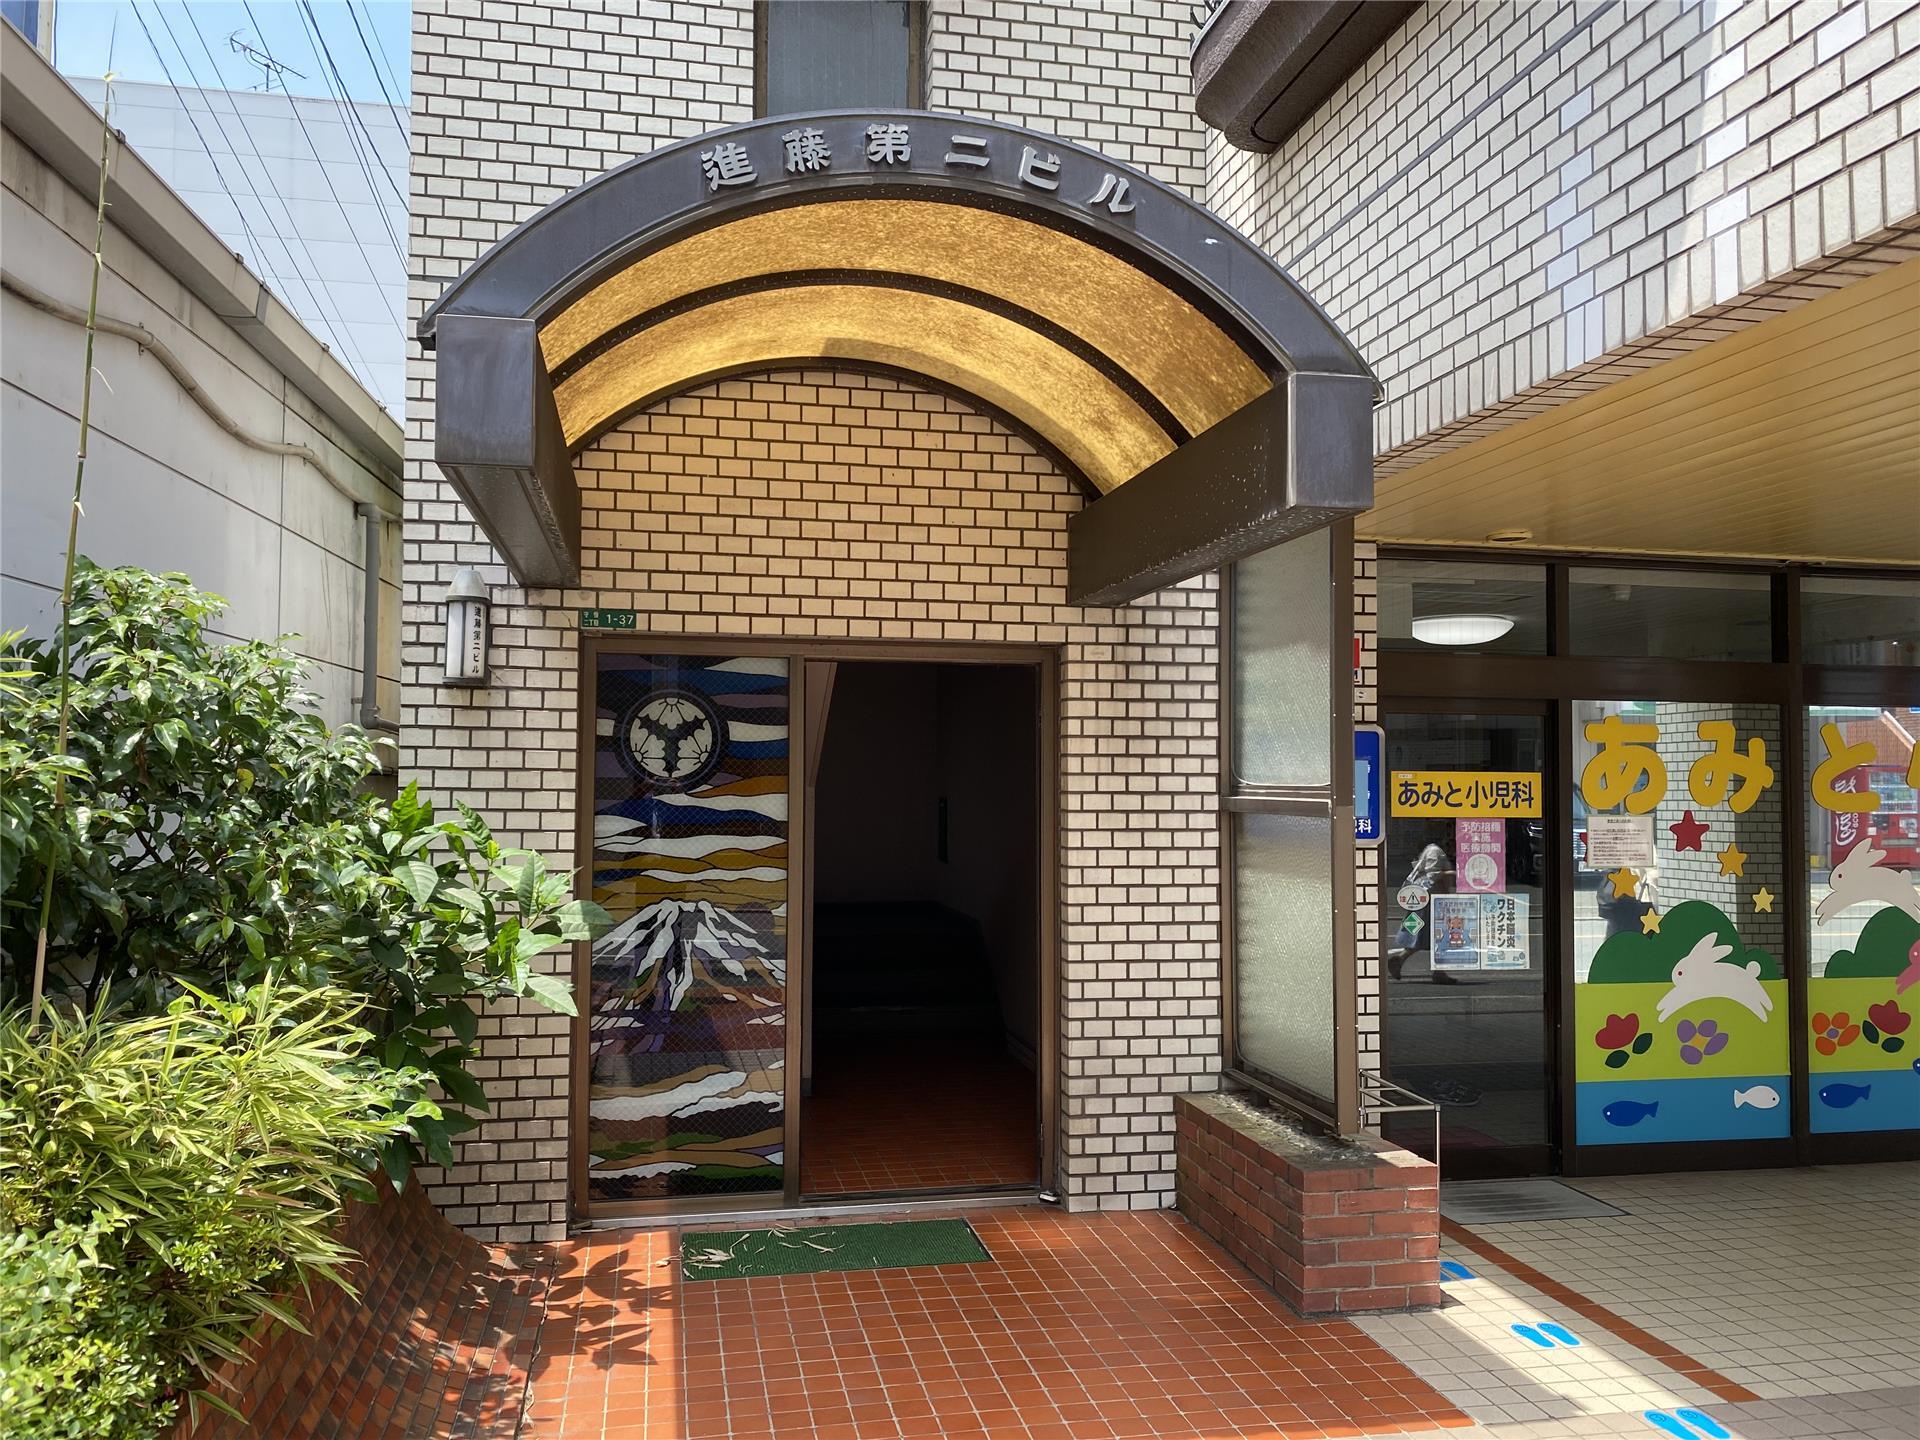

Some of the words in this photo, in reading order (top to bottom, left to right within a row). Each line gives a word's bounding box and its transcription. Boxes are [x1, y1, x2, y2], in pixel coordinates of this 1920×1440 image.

[702, 123, 1137, 214] 進藤第二ビル
[606, 613, 634, 625] 1-37
[1581, 715, 1920, 814] あみと
[1398, 780, 1534, 809] あみと小児科
[1497, 898, 1506, 948] ワクチン
